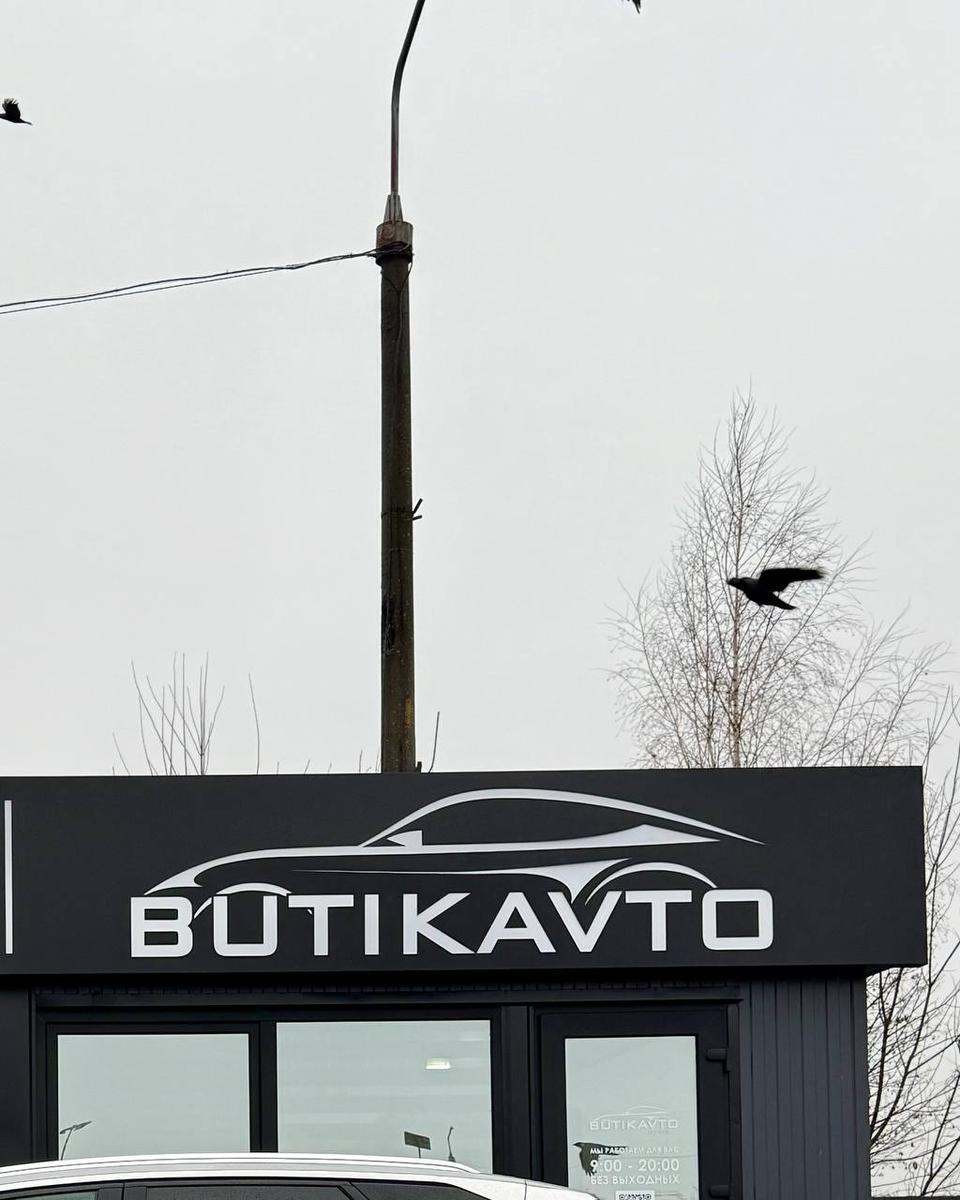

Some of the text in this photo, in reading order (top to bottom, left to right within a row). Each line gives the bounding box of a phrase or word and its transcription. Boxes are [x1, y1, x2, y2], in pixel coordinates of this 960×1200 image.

[130, 888, 774, 958] BUTIKAVTO
[590, 1119, 678, 1130] BUTIKAVTO
[590, 1159, 622, 1173] 9:00
[638, 1158, 680, 1172] 20:00
[590, 1175, 680, 1185] БЕЗ ВЫХОДНЫХ
